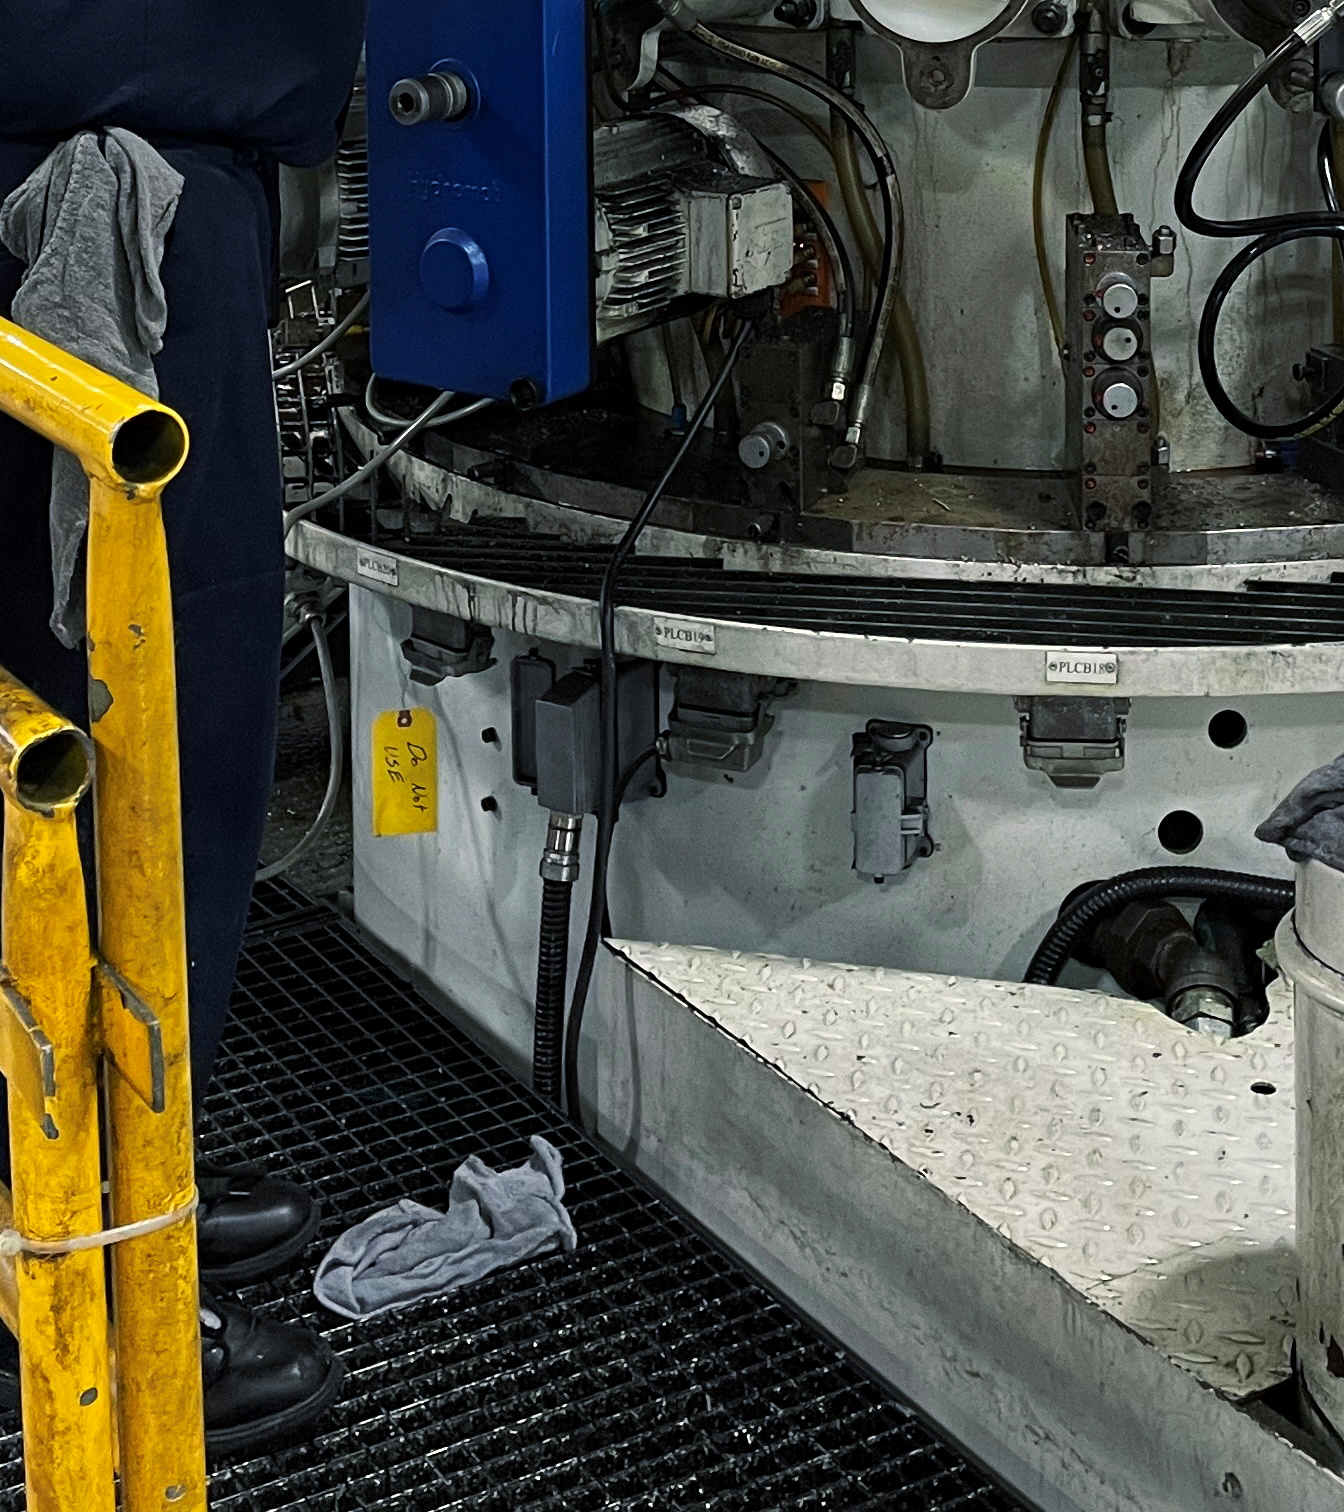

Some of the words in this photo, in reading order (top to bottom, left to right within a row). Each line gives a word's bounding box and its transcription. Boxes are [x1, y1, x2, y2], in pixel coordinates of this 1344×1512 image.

[663, 626, 705, 643] PLCB19
[1058, 661, 1106, 675] PLCB18
[384, 745, 405, 783] USE
[407, 741, 428, 767] Do
[411, 782, 428, 813] Not
